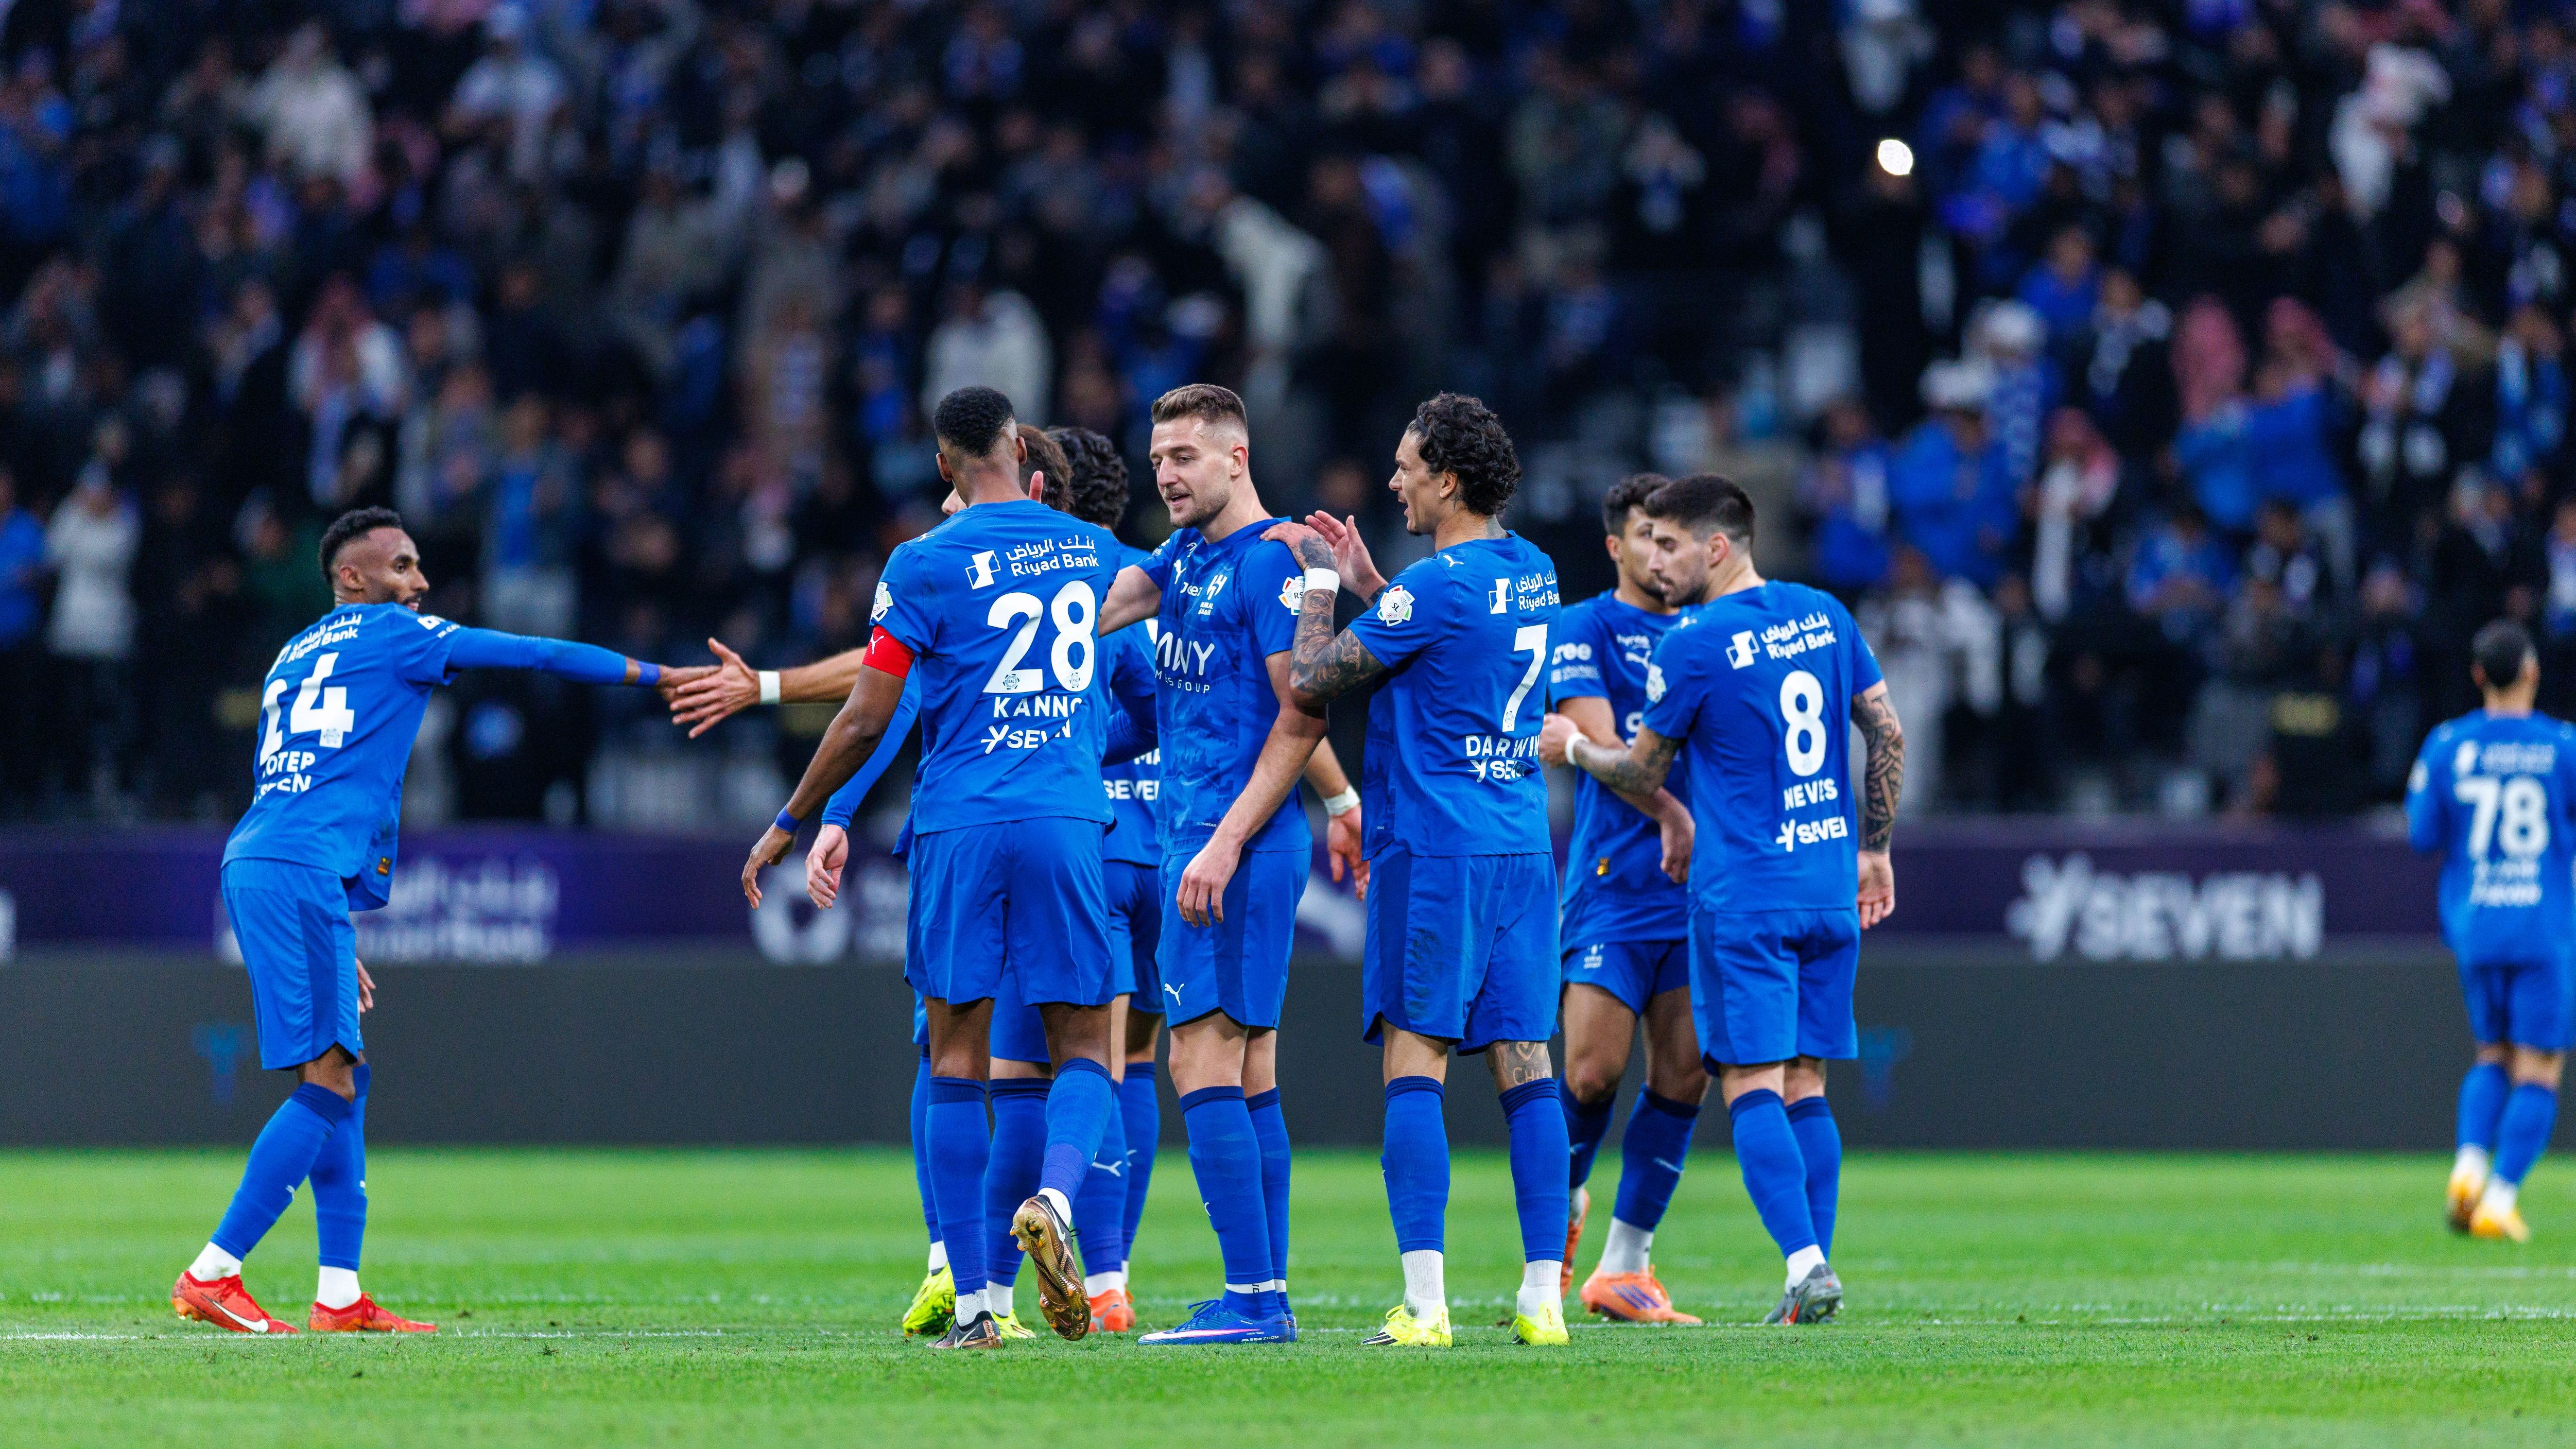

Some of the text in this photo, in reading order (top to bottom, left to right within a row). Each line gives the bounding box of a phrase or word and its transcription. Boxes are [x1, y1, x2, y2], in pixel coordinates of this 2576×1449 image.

[1006, 535, 1096, 561] بنك الرياض
[1011, 554, 1100, 577] Riyad Bank
[1515, 573, 1544, 593] الرياض
[1518, 592, 1546, 612] Riyad
[321, 625, 358, 646] Bank
[981, 580, 1096, 693] 28
[1766, 629, 1837, 660] Riyad Bank
[1502, 623, 1548, 732] 7
[1779, 670, 1827, 777] 8
[2454, 777, 2551, 861] 78
